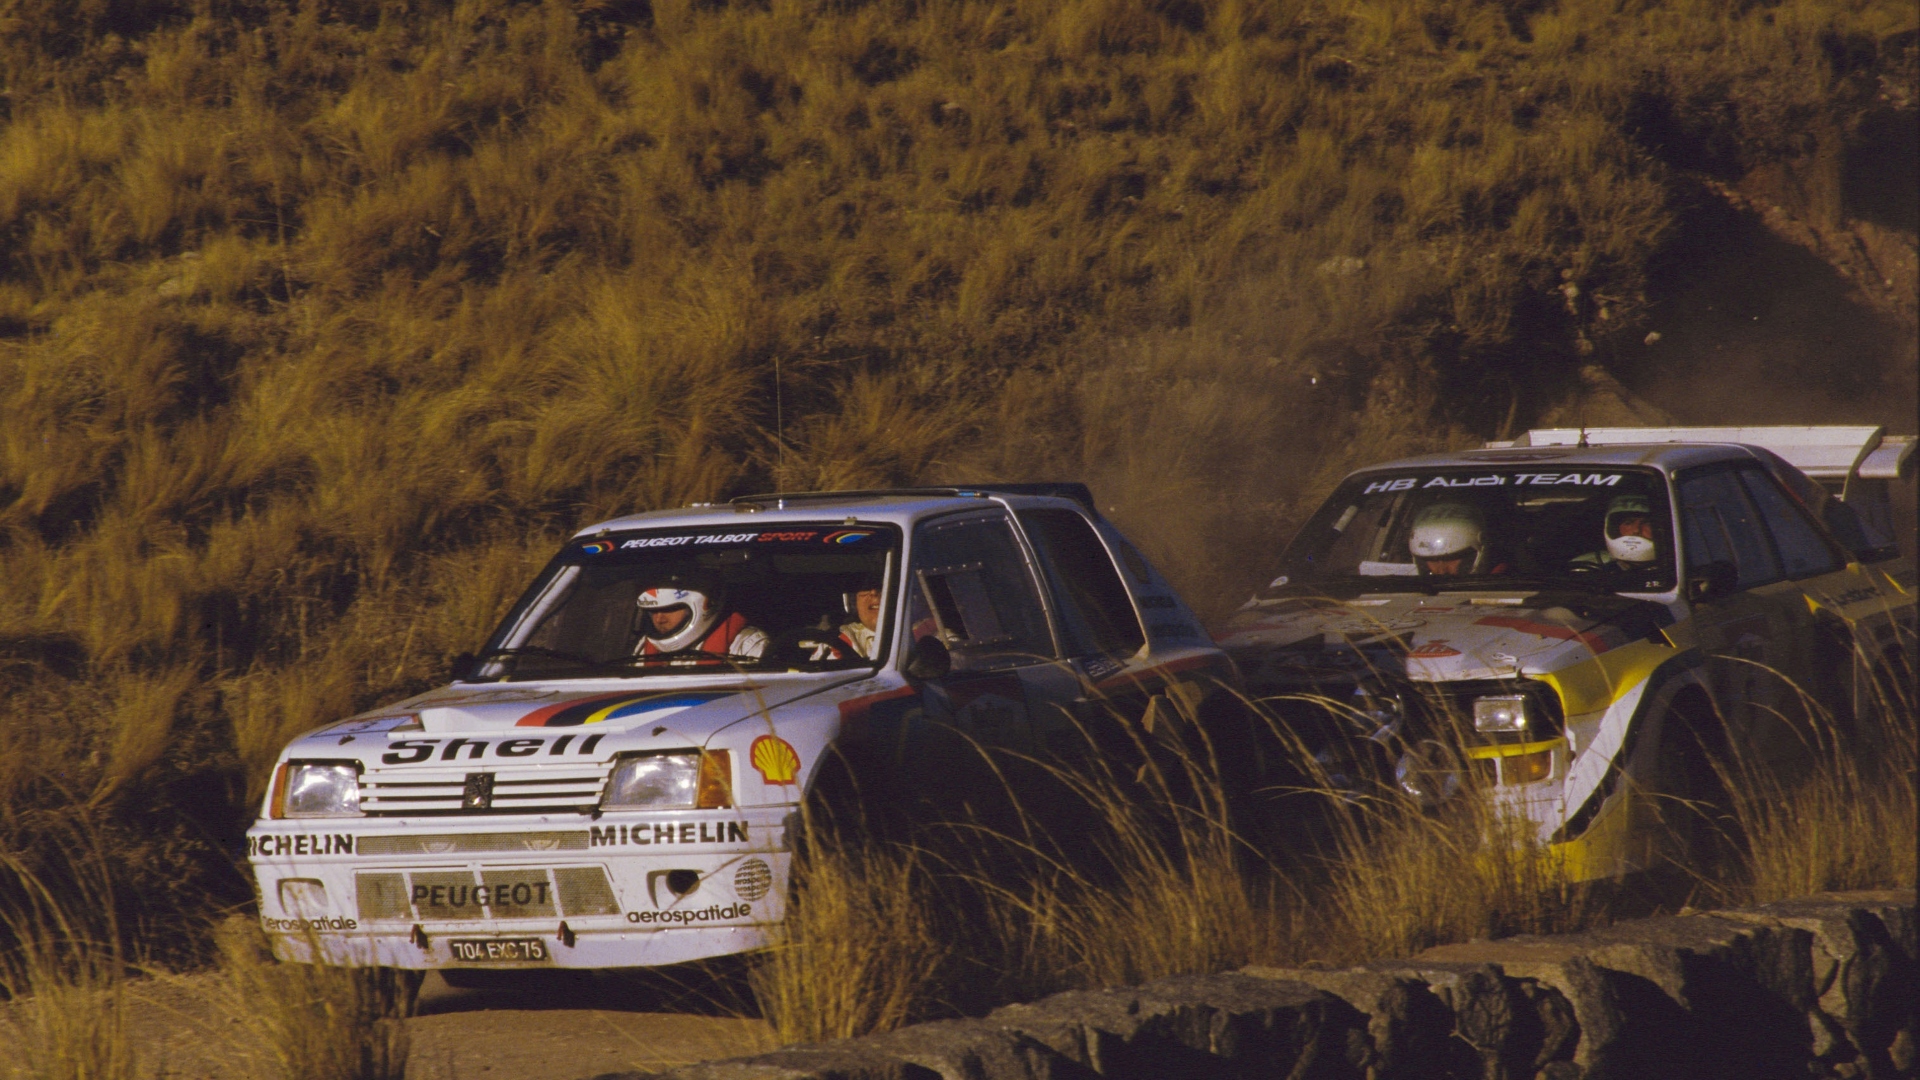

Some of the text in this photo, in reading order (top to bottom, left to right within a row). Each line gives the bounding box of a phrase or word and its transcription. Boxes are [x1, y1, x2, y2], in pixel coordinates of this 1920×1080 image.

[1363, 473, 1623, 494] HB Audi TEAM
[620, 531, 818, 549] PEUGEOT TALBOT SPORT
[381, 733, 607, 765] Shell
[247, 833, 353, 856] ICHELIN
[590, 820, 749, 847] MICHELIN
[411, 881, 551, 907] PEUGEOT
[626, 902, 752, 925] aerospatiale
[453, 942, 484, 959] 704
[519, 942, 542, 958] 75
